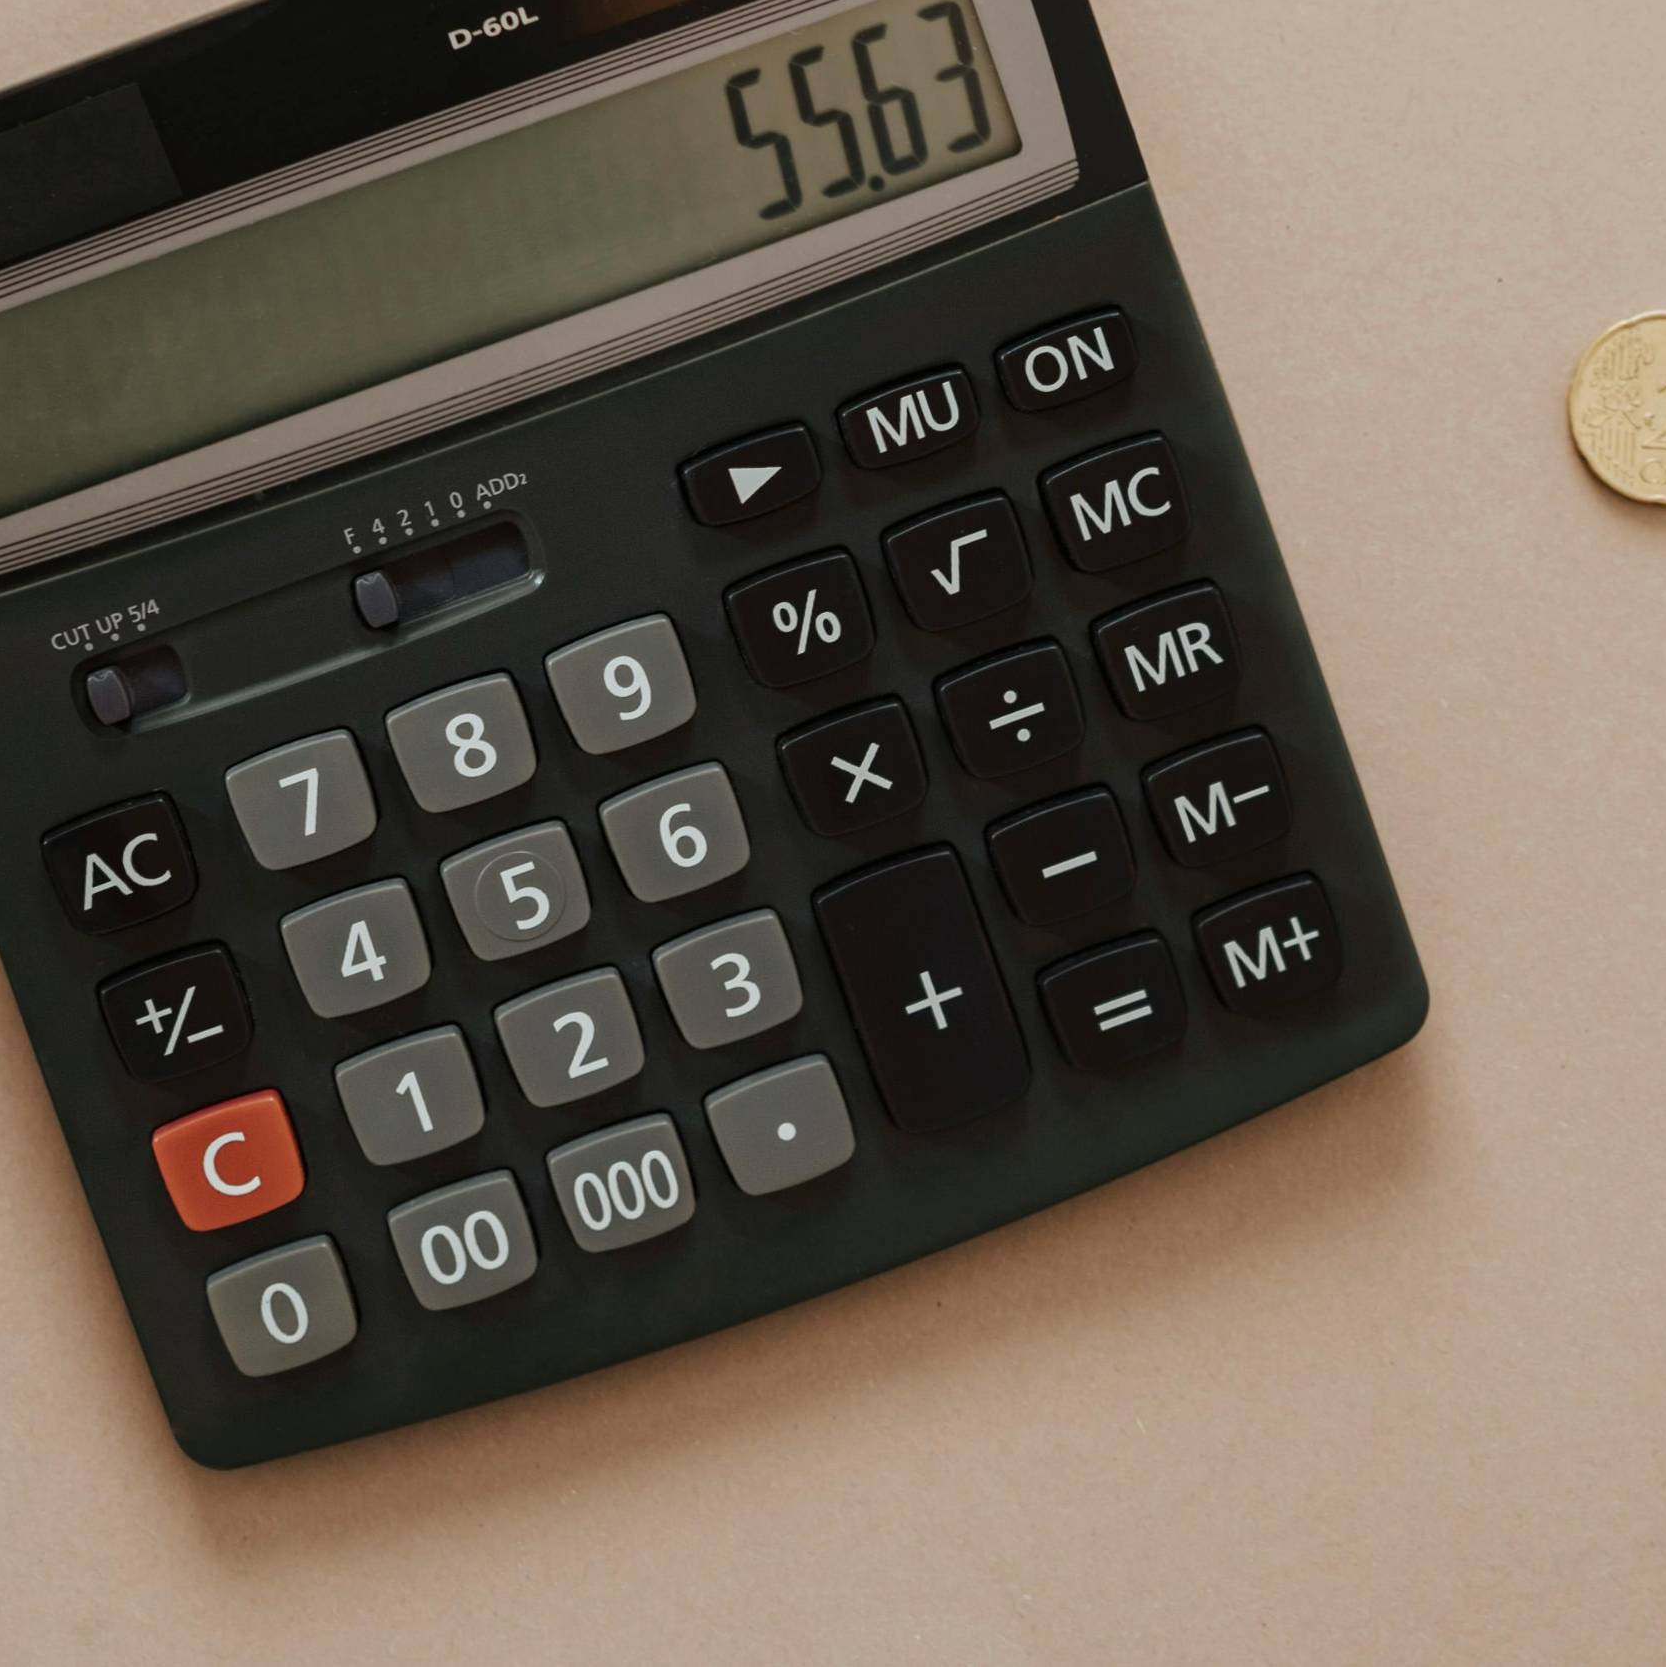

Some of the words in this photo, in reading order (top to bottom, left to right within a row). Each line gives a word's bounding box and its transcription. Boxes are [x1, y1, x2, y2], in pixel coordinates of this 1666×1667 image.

[446, 5, 541, 51] D-60L
[1025, 326, 1115, 393] ON
[866, 380, 959, 454] MU
[343, 528, 357, 546] F
[371, 518, 386, 536] 4
[396, 508, 413, 528] 2
[423, 499, 436, 518] 1
[1069, 466, 1171, 541] MC
[50, 623, 95, 652] CUT
[95, 612, 125, 639] UP
[127, 598, 162, 626] 5/4
[1124, 622, 1224, 692] MR
[603, 655, 651, 721] 9
[445, 713, 497, 777] 8
[279, 767, 319, 836] 7
[659, 803, 707, 867] 6
[83, 833, 172, 911] AC
[500, 861, 550, 930] 5
[341, 920, 387, 981] 4
[1223, 917, 1319, 988] M+
[710, 953, 761, 1017] 3
[553, 1011, 609, 1079] 2
[396, 1071, 433, 1132] 1
[203, 1131, 261, 1196] C
[574, 1150, 678, 1230] 000
[421, 1210, 509, 1284] 00
[261, 1283, 308, 1343] 0
